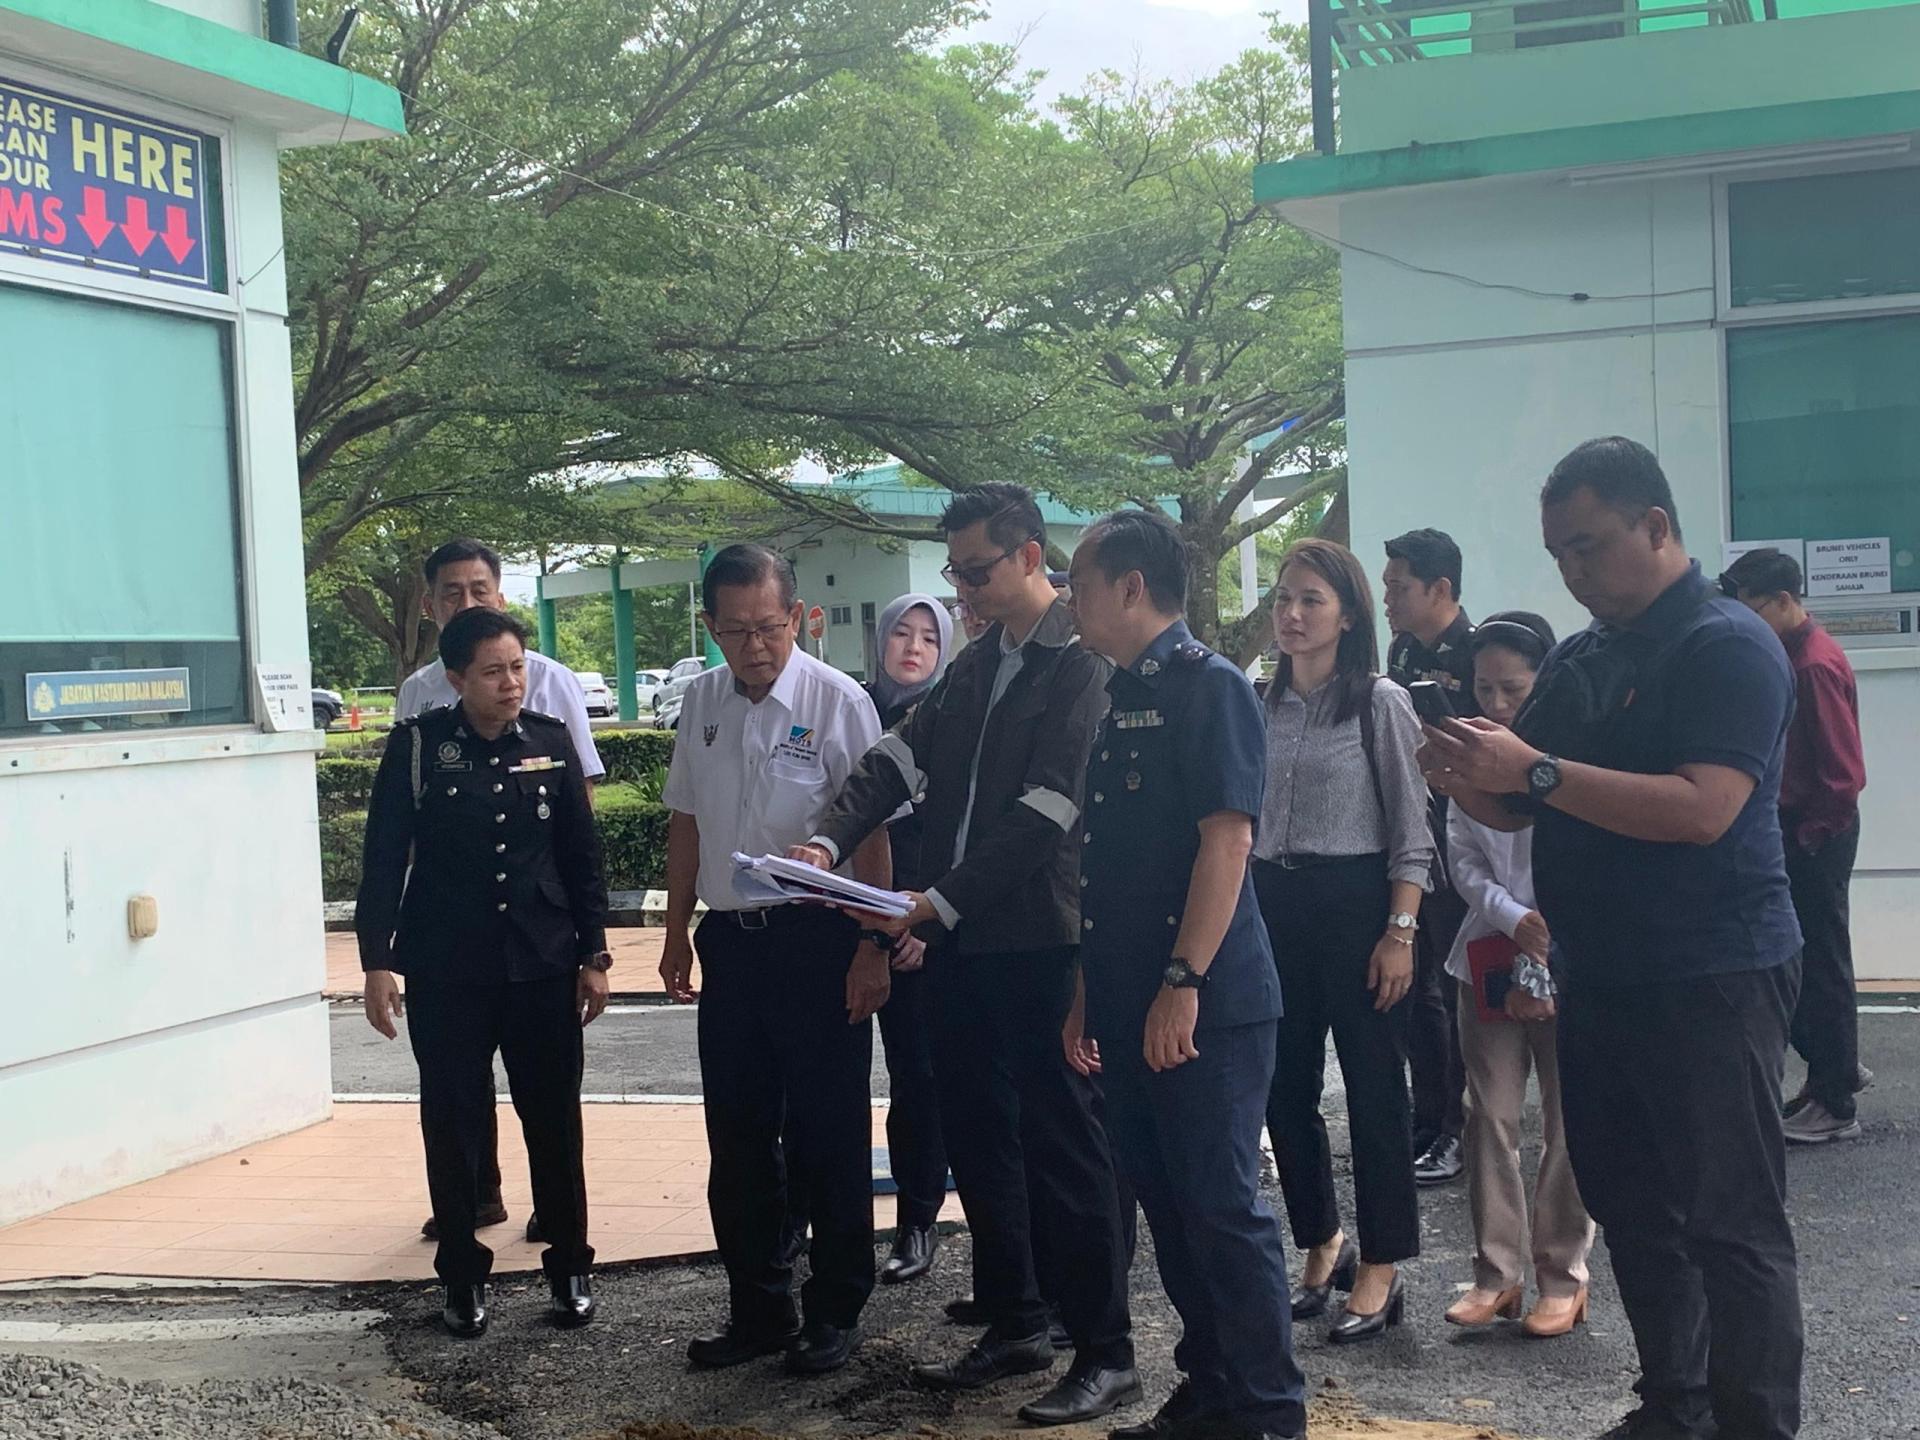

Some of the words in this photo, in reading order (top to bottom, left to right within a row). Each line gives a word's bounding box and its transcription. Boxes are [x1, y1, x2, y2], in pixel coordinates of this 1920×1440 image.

[0, 124, 48, 161] AN
[71, 116, 194, 199] HERE
[1816, 544, 1844, 553] BRUNEI
[1846, 542, 1881, 551] VEHICLES
[1839, 555, 1859, 563] ONLY
[1811, 572, 1858, 581] KENDERAAN
[1860, 570, 1888, 579] BRUNEI
[150, 679, 185, 700] MALAYSIA
